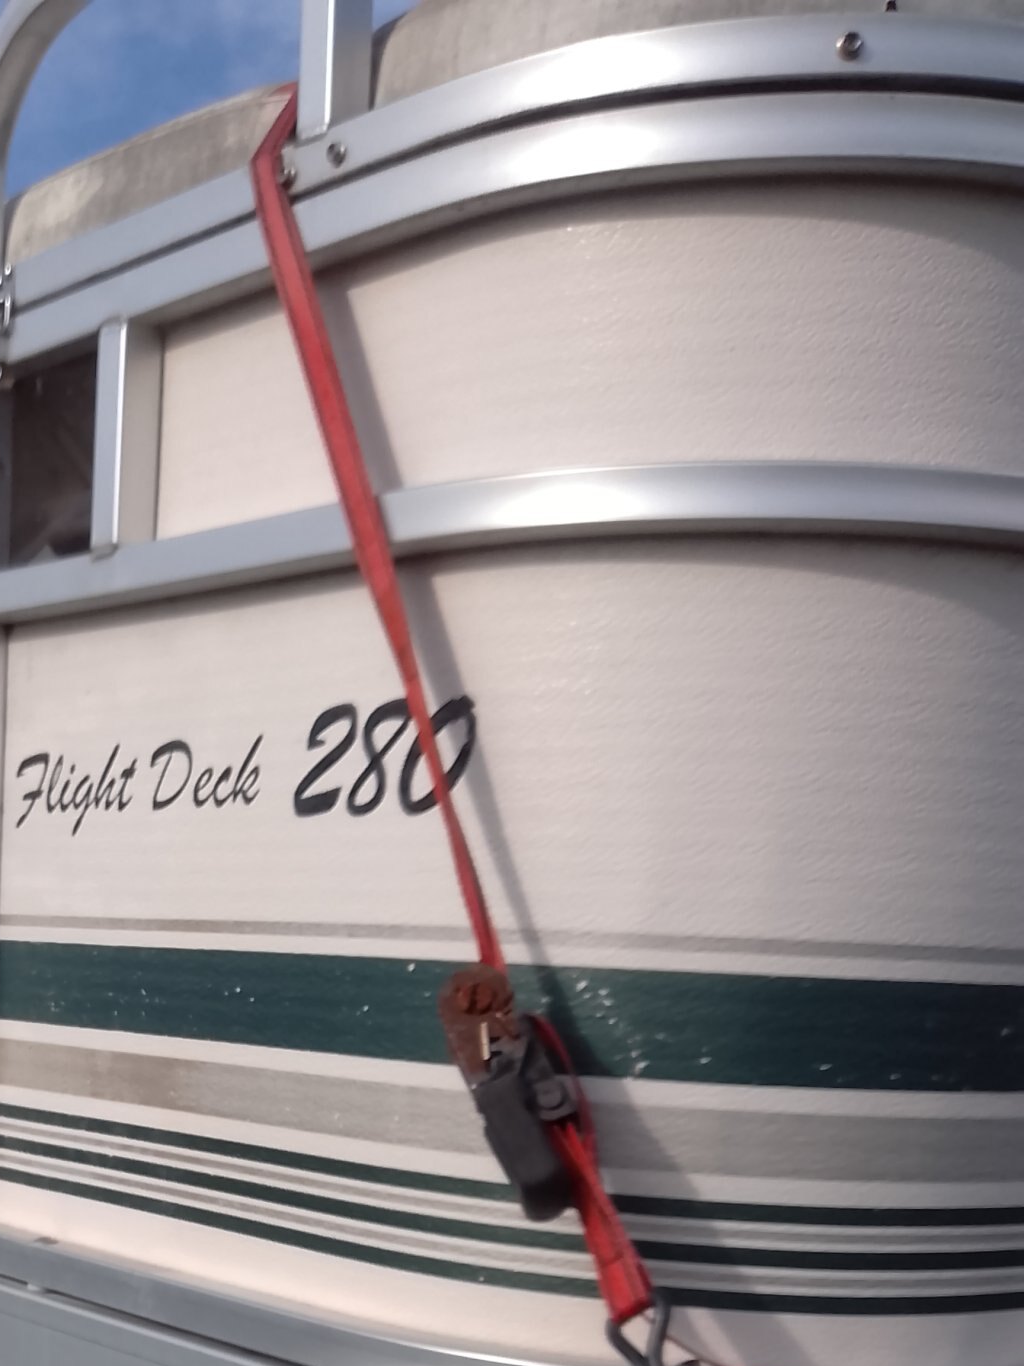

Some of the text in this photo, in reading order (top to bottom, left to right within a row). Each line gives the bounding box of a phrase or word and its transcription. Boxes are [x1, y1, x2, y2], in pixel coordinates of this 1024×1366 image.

[16, 695, 475, 836] Flight Deck 280
